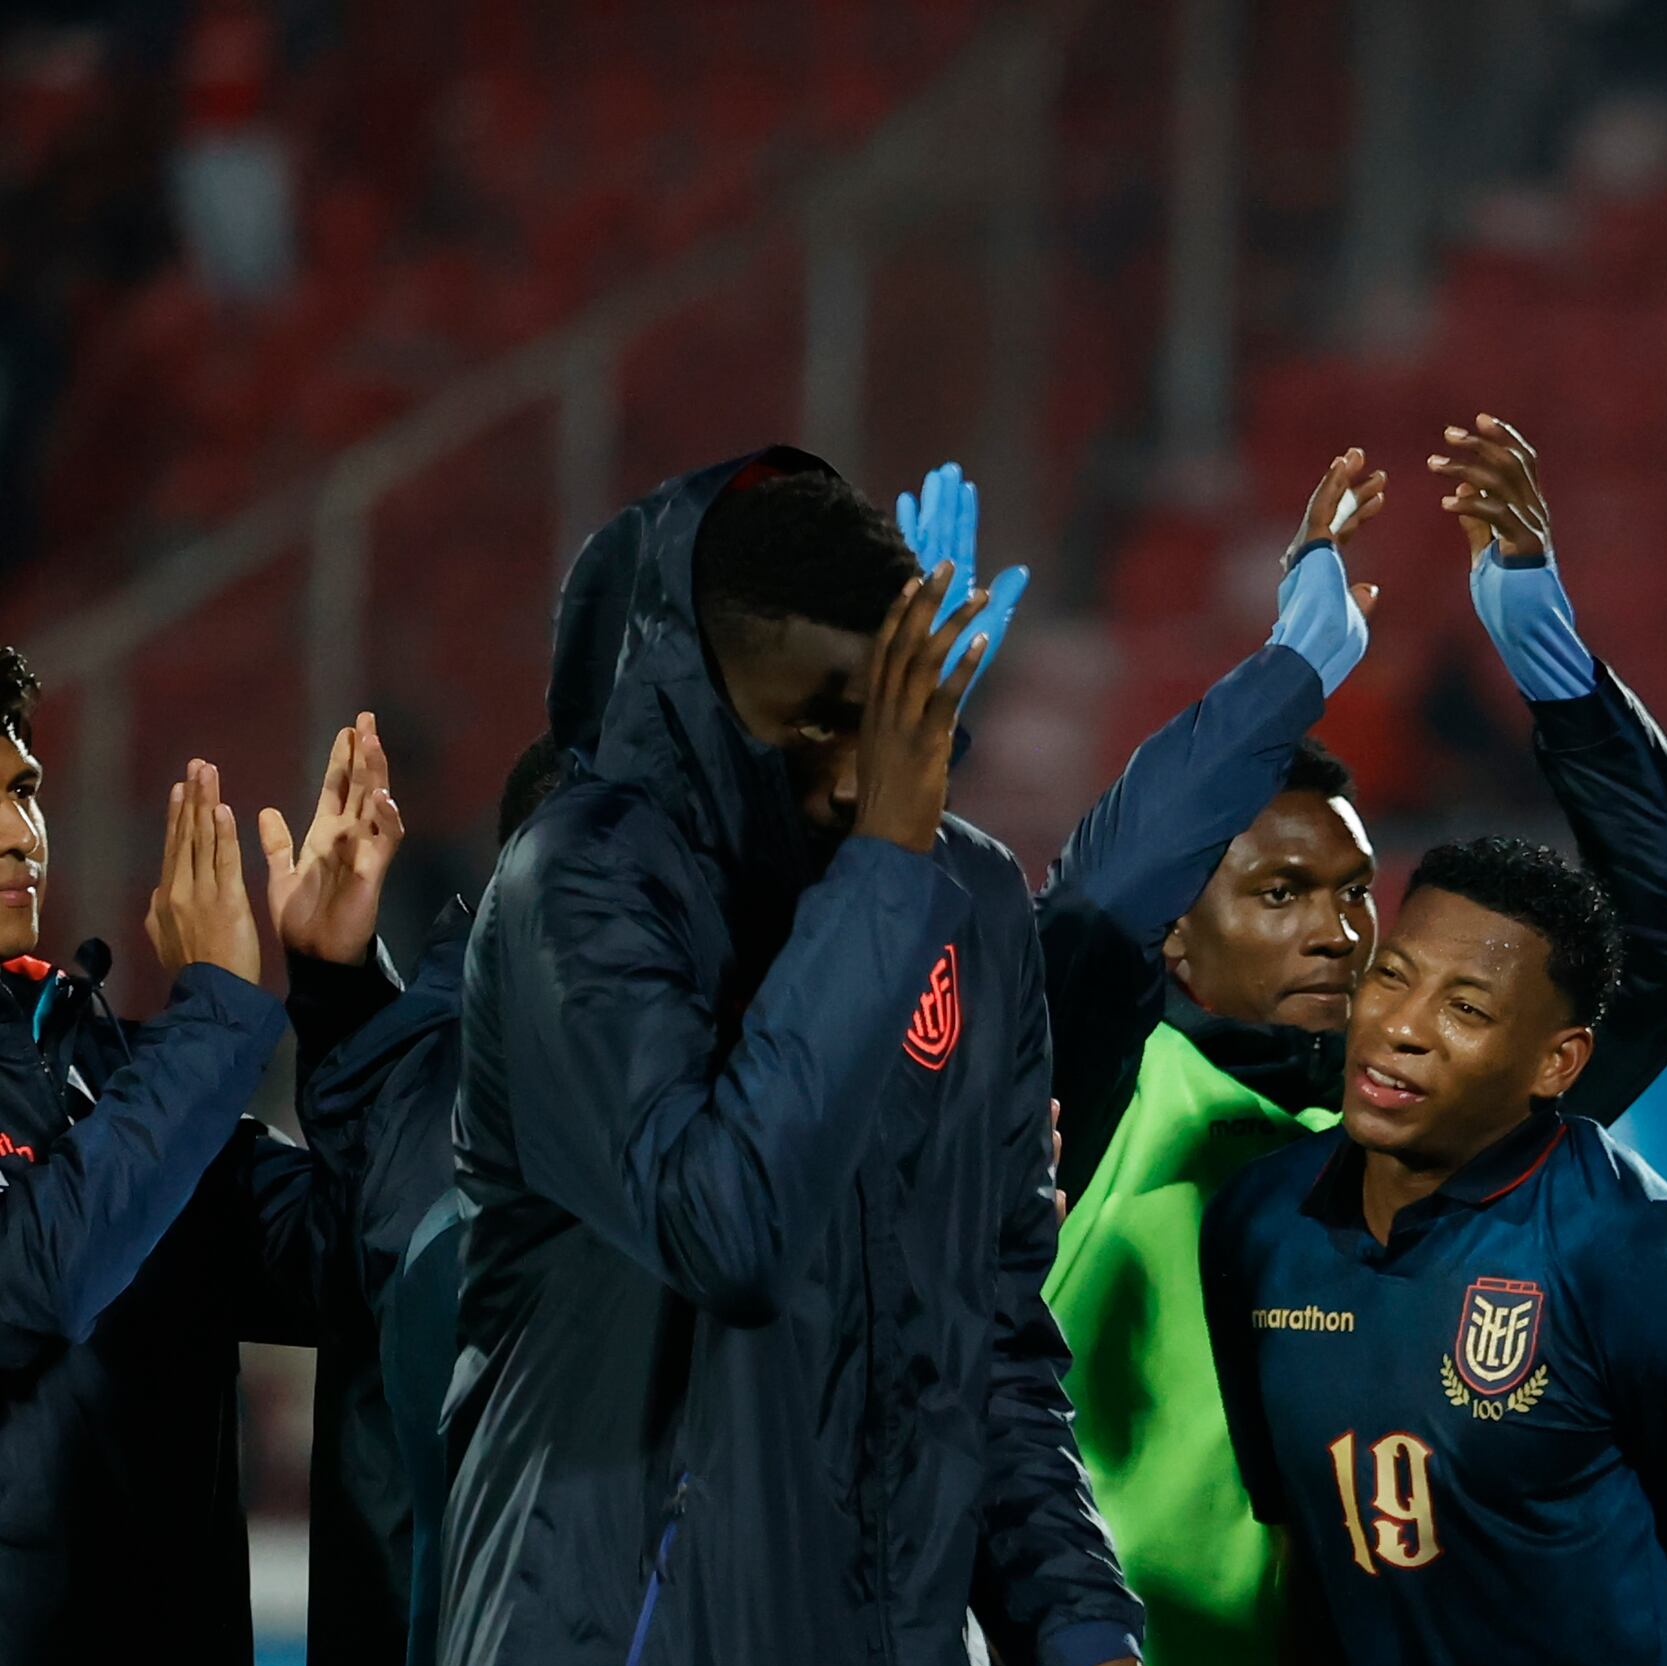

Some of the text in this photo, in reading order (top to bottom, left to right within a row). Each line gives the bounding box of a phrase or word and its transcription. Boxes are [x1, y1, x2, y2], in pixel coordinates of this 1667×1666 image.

[1252, 1306, 1355, 1333] marathon
[1472, 1398, 1504, 1421] 100
[1328, 1428, 1444, 1577] 19
